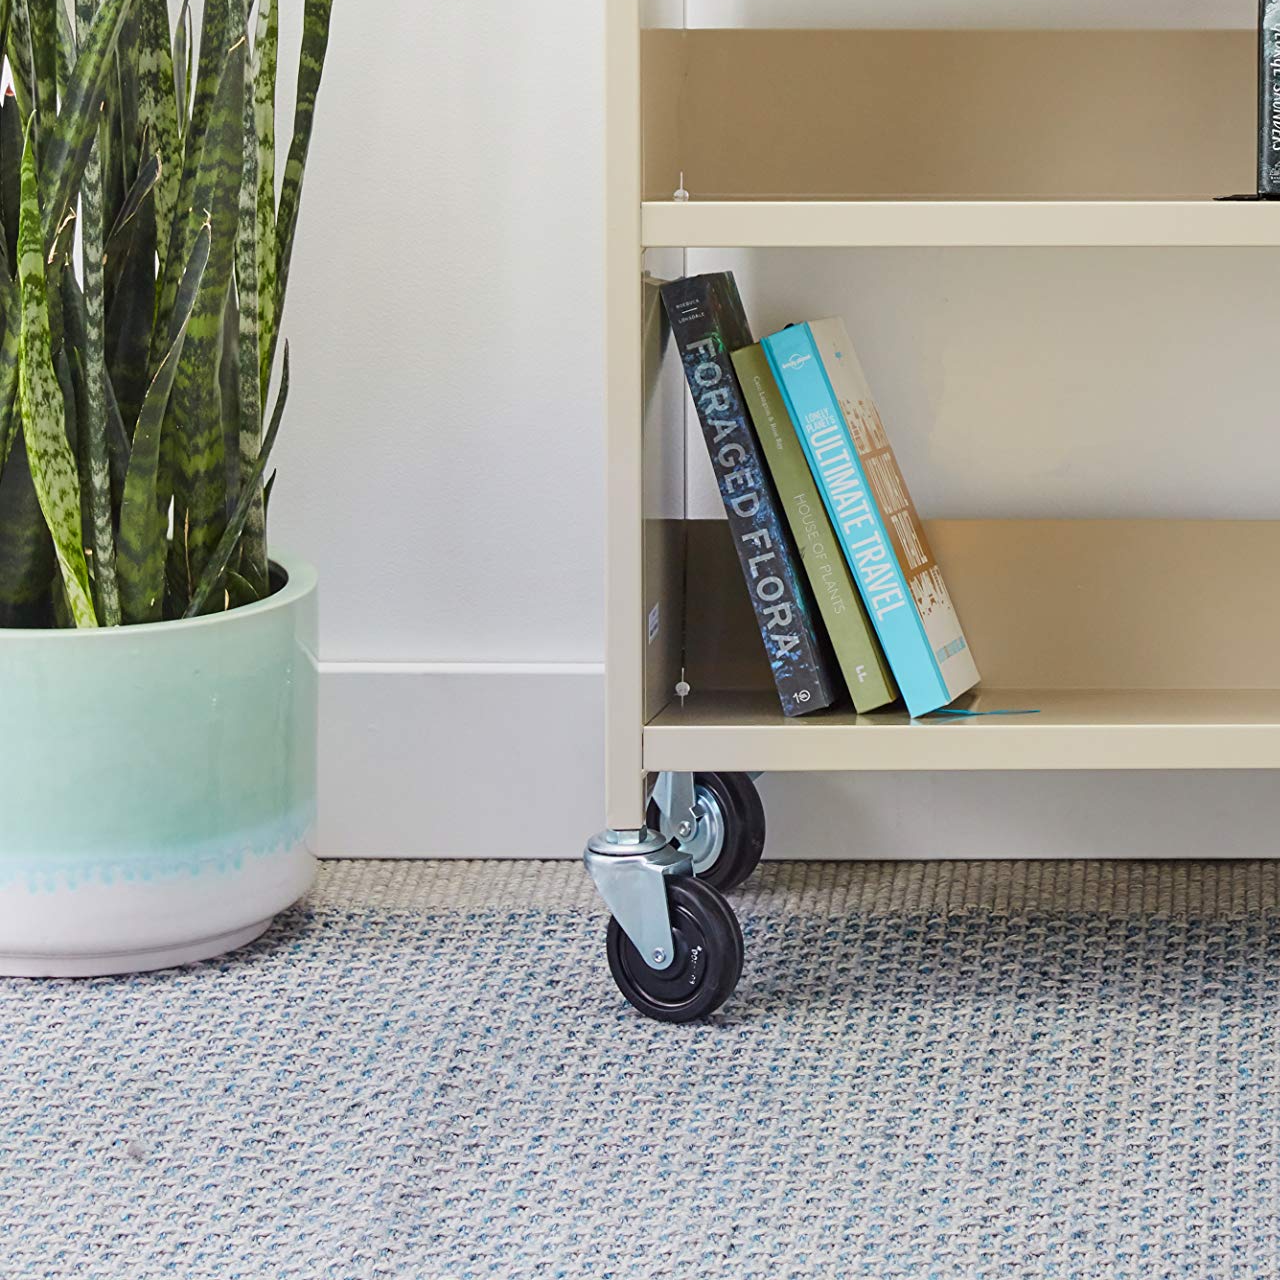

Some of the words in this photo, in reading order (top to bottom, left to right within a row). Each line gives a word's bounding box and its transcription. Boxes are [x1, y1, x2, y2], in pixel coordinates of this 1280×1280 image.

[686, 336, 761, 518] FORAGED
[741, 528, 800, 659] FLORA
[793, 493, 819, 540] HOUSE
[811, 542, 828, 561] OF
[820, 564, 846, 615] PLANTS
[810, 425, 875, 535] ULTIMATE
[851, 530, 906, 621] TRAVEL
